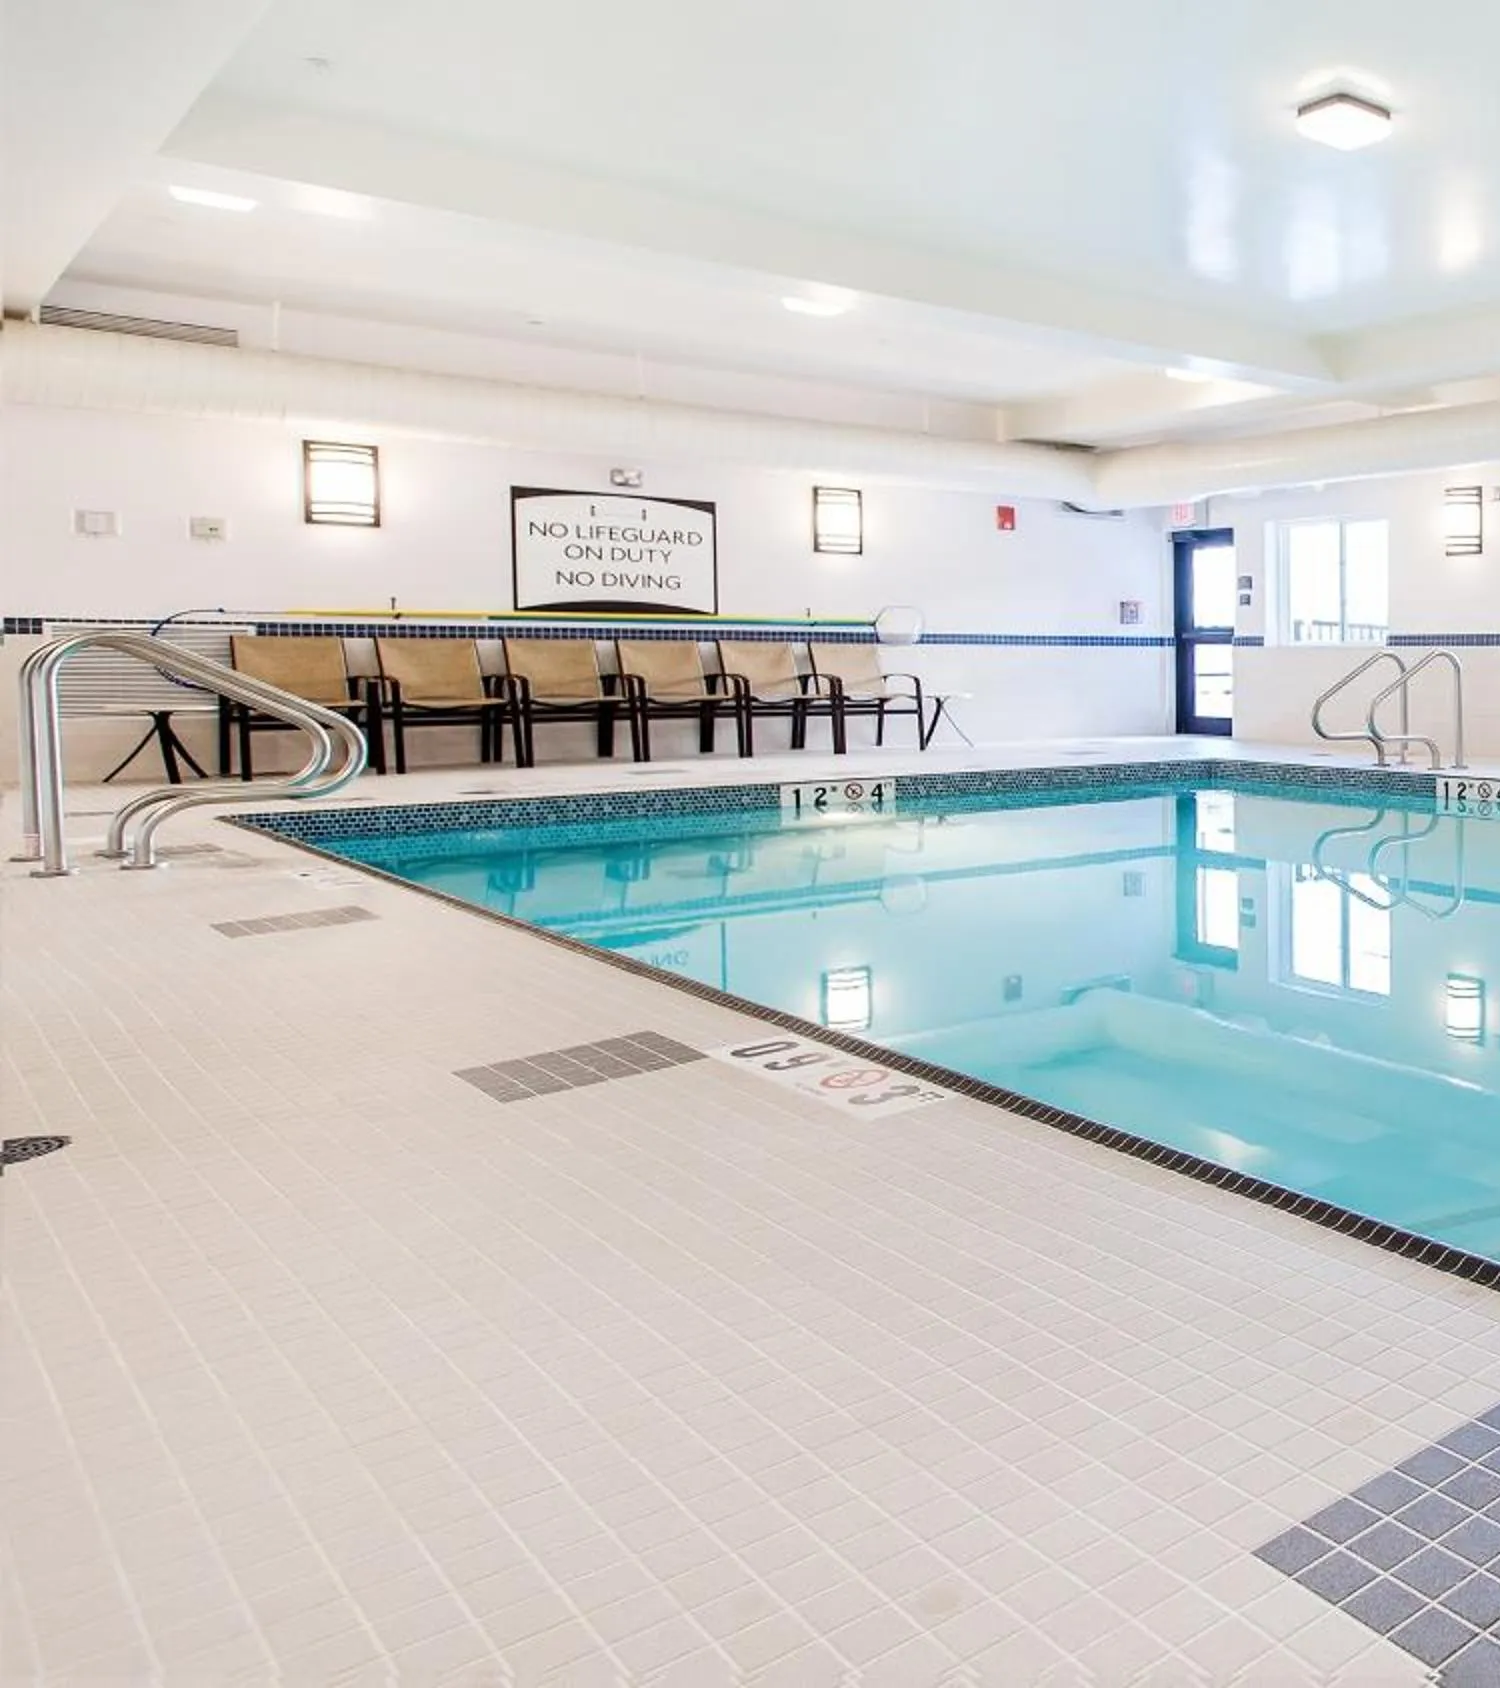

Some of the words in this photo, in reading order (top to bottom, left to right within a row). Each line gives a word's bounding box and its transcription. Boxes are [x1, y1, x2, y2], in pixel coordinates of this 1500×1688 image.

[529, 521, 569, 539] NO
[576, 525, 703, 547] LIFEGUARD
[564, 543, 603, 561] ON
[610, 547, 672, 563] DUTY
[556, 570, 595, 587] NO
[602, 572, 682, 590] DIVING
